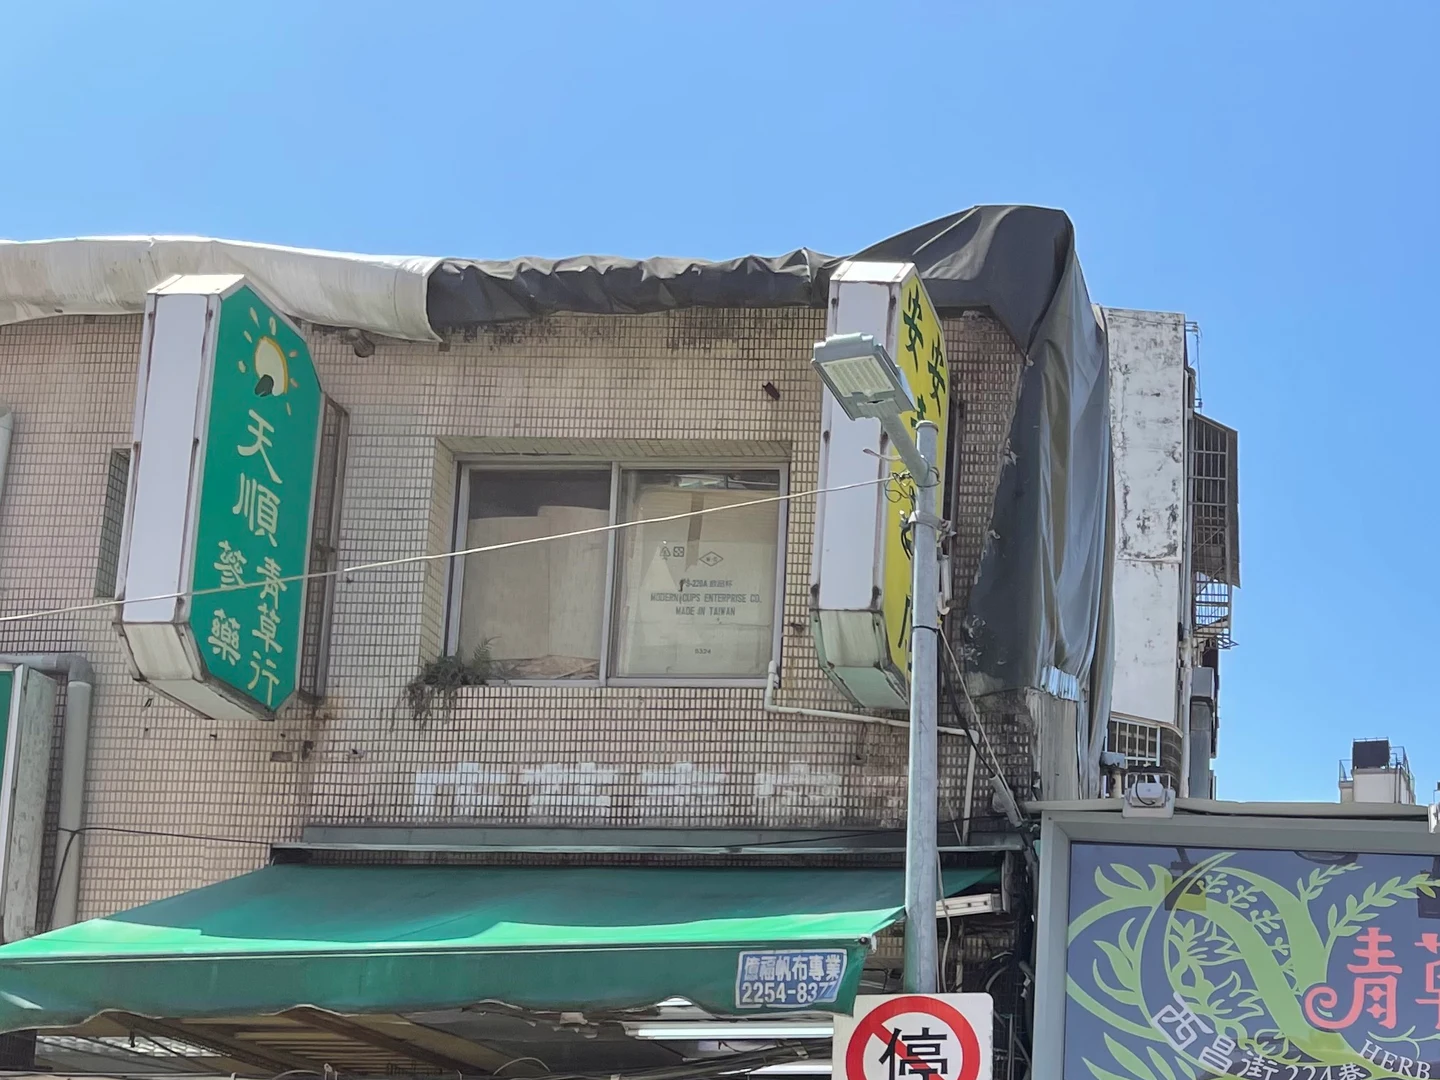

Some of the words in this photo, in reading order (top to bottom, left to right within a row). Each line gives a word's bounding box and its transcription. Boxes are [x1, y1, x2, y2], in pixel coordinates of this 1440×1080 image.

[232, 409, 283, 547] 天順
[704, 594, 746, 603] ENTERPRISE
[676, 606, 694, 616] MADE
[709, 607, 735, 616] TAIWAN
[742, 981, 837, 1003] 2254-8377
[1358, 1039, 1431, 1080] HERB
